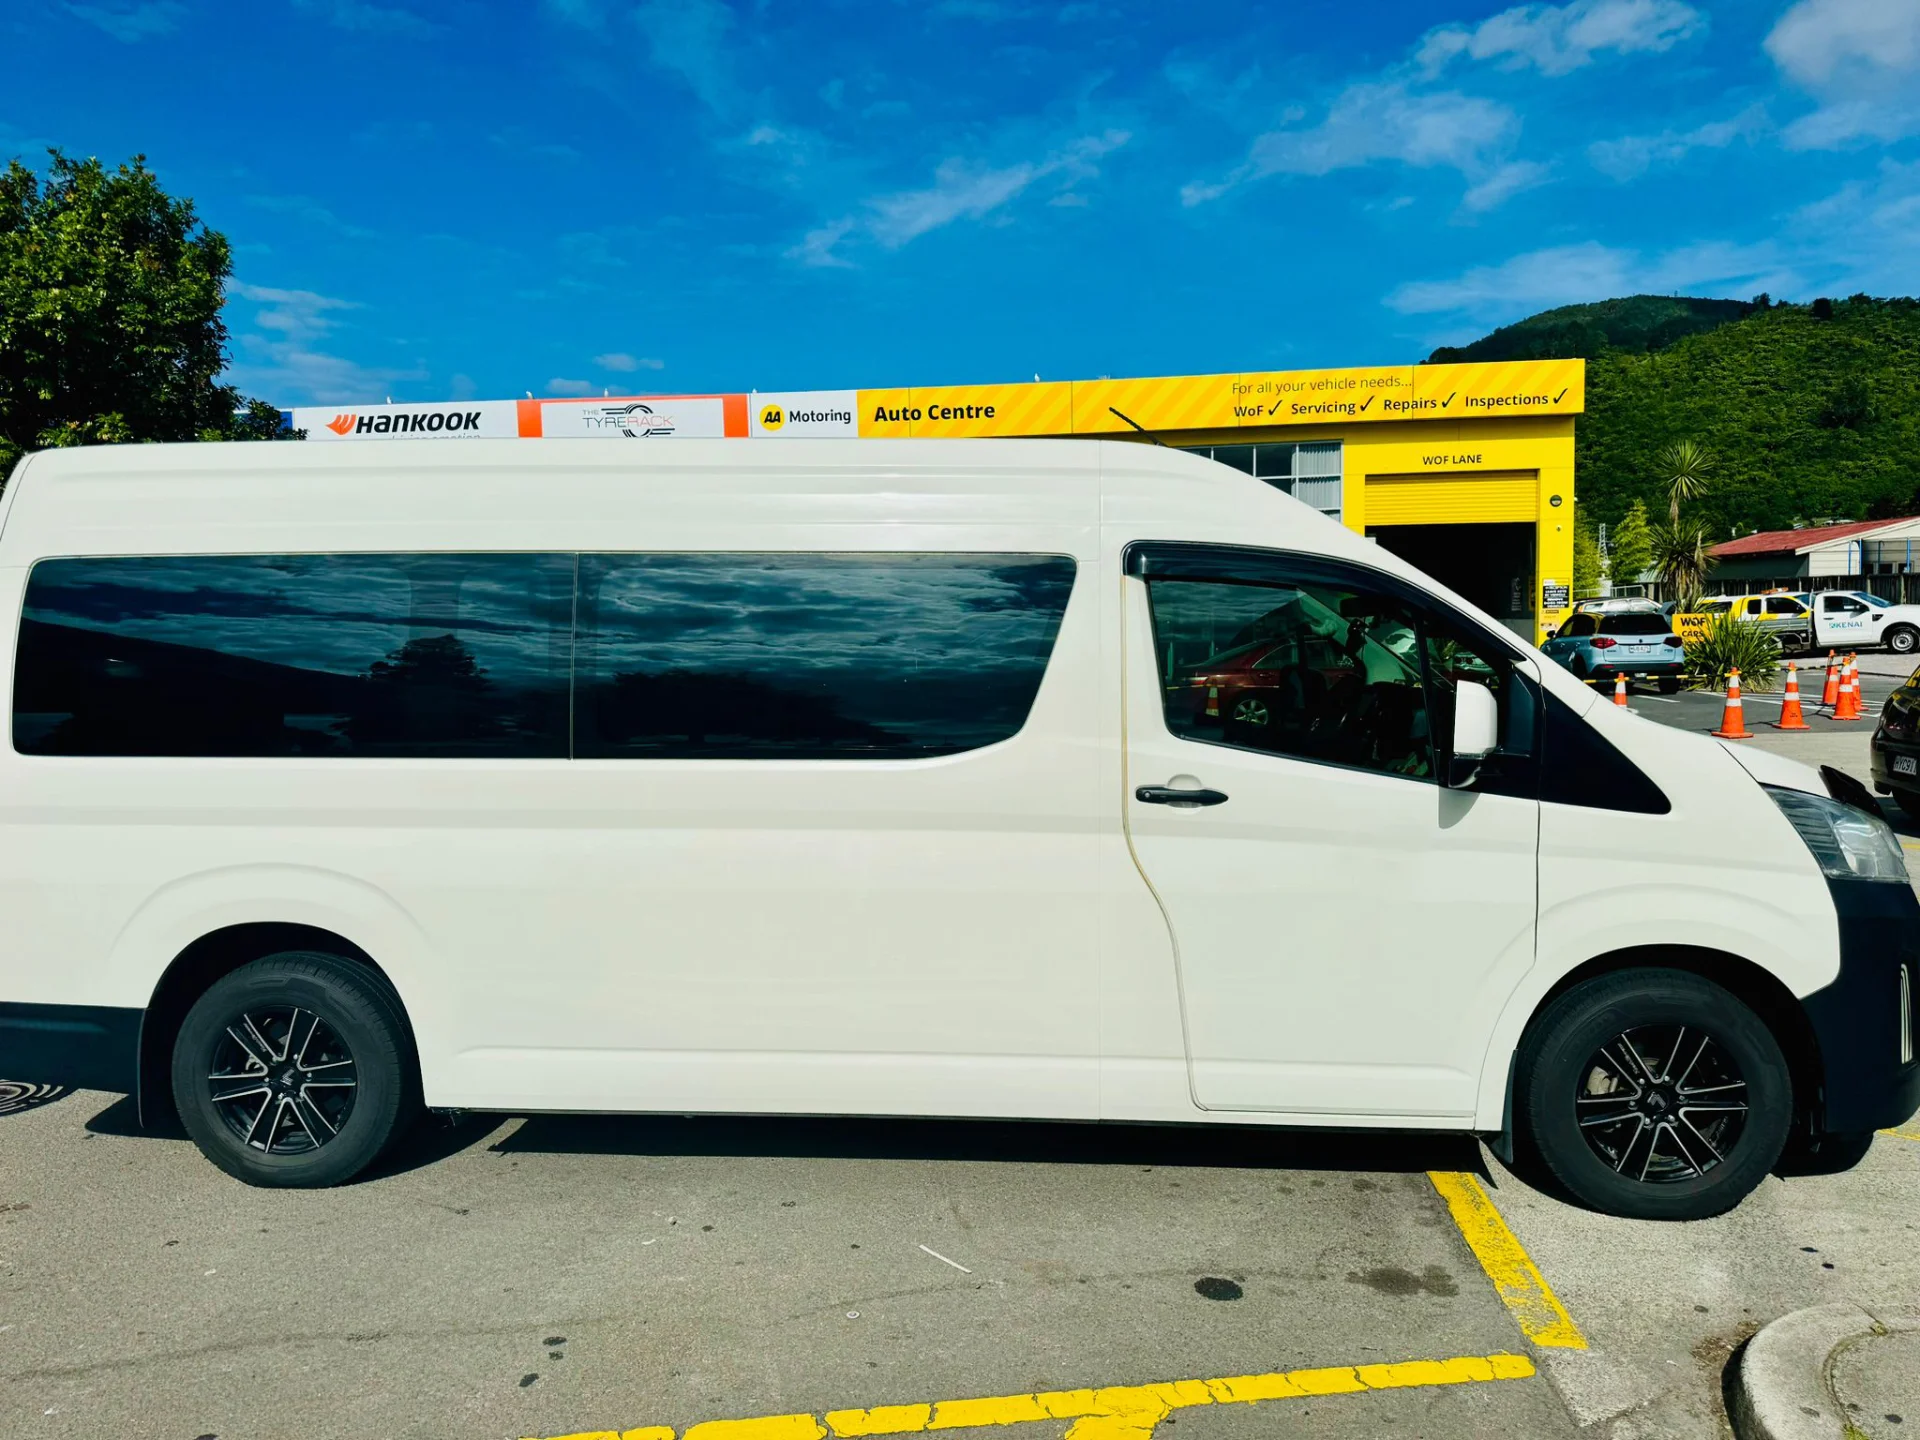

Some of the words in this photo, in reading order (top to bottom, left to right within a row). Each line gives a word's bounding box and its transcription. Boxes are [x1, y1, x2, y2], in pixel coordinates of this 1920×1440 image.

[1232, 381, 1254, 395] For
[1256, 380, 1272, 394] all
[1275, 382, 1307, 397] your
[1309, 376, 1357, 392] vehicle
[874, 405, 922, 422] Auto
[928, 403, 995, 421] Centre
[1233, 404, 1264, 417] WoF
[1291, 400, 1356, 417] Servicing
[1383, 396, 1437, 414] Repairs
[1465, 393, 1548, 410] Inspections
[764, 411, 782, 424] AA
[789, 407, 852, 425] Motoring
[1422, 455, 1449, 466] WOF
[1452, 454, 1482, 465] LANE
[1680, 617, 1706, 627] WOF
